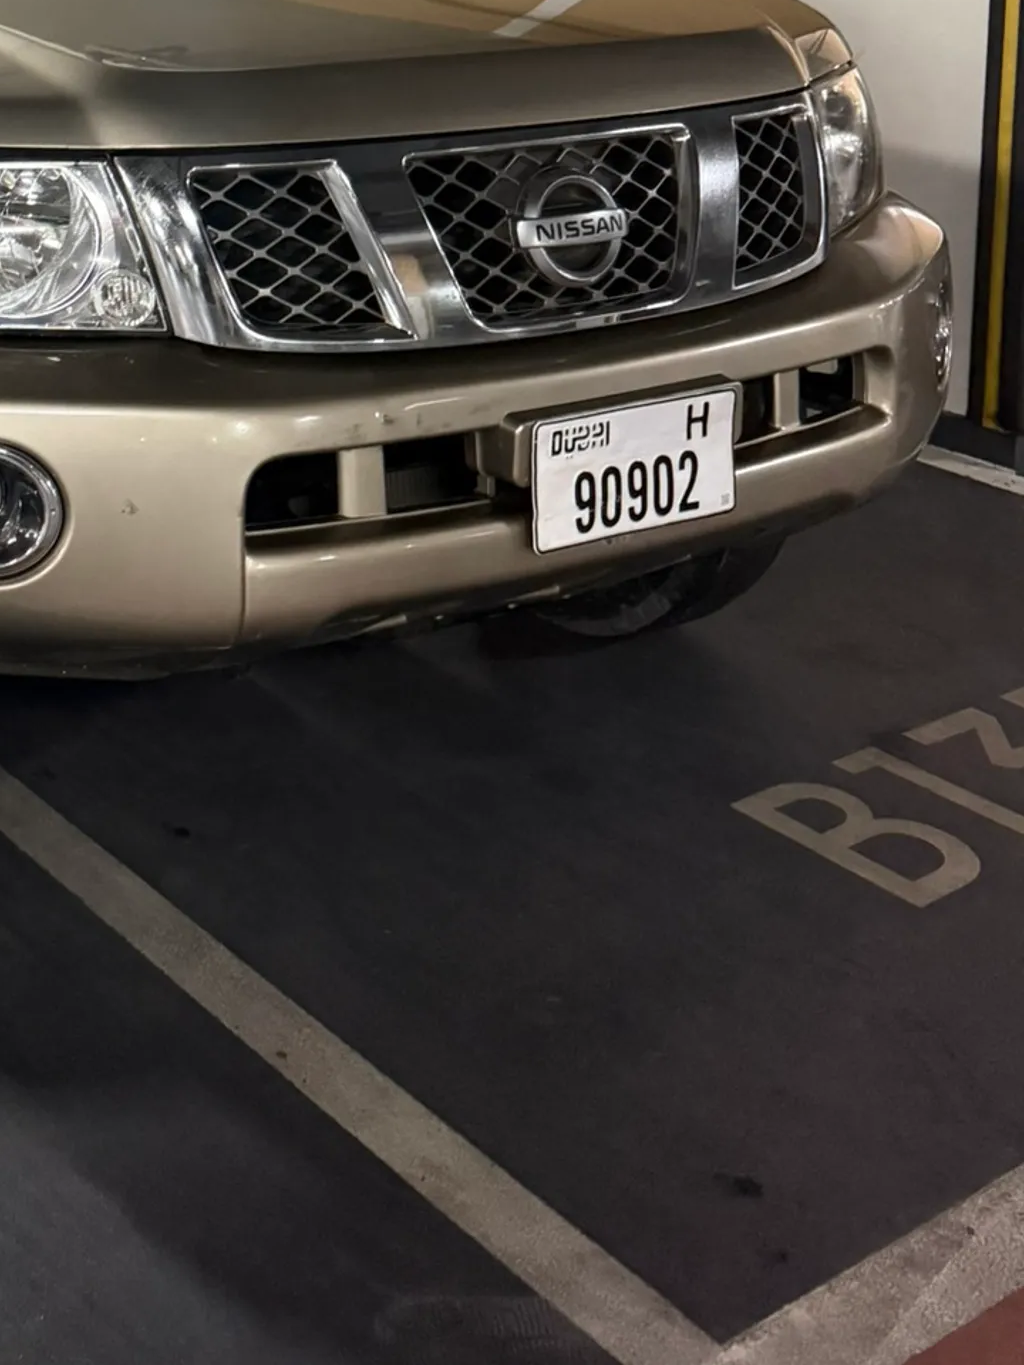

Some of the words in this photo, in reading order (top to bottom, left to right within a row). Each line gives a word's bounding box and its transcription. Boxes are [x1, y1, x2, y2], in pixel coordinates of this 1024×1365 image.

[535, 213, 624, 243] NISSAN
[686, 401, 711, 441] H
[575, 449, 700, 534] 90902
